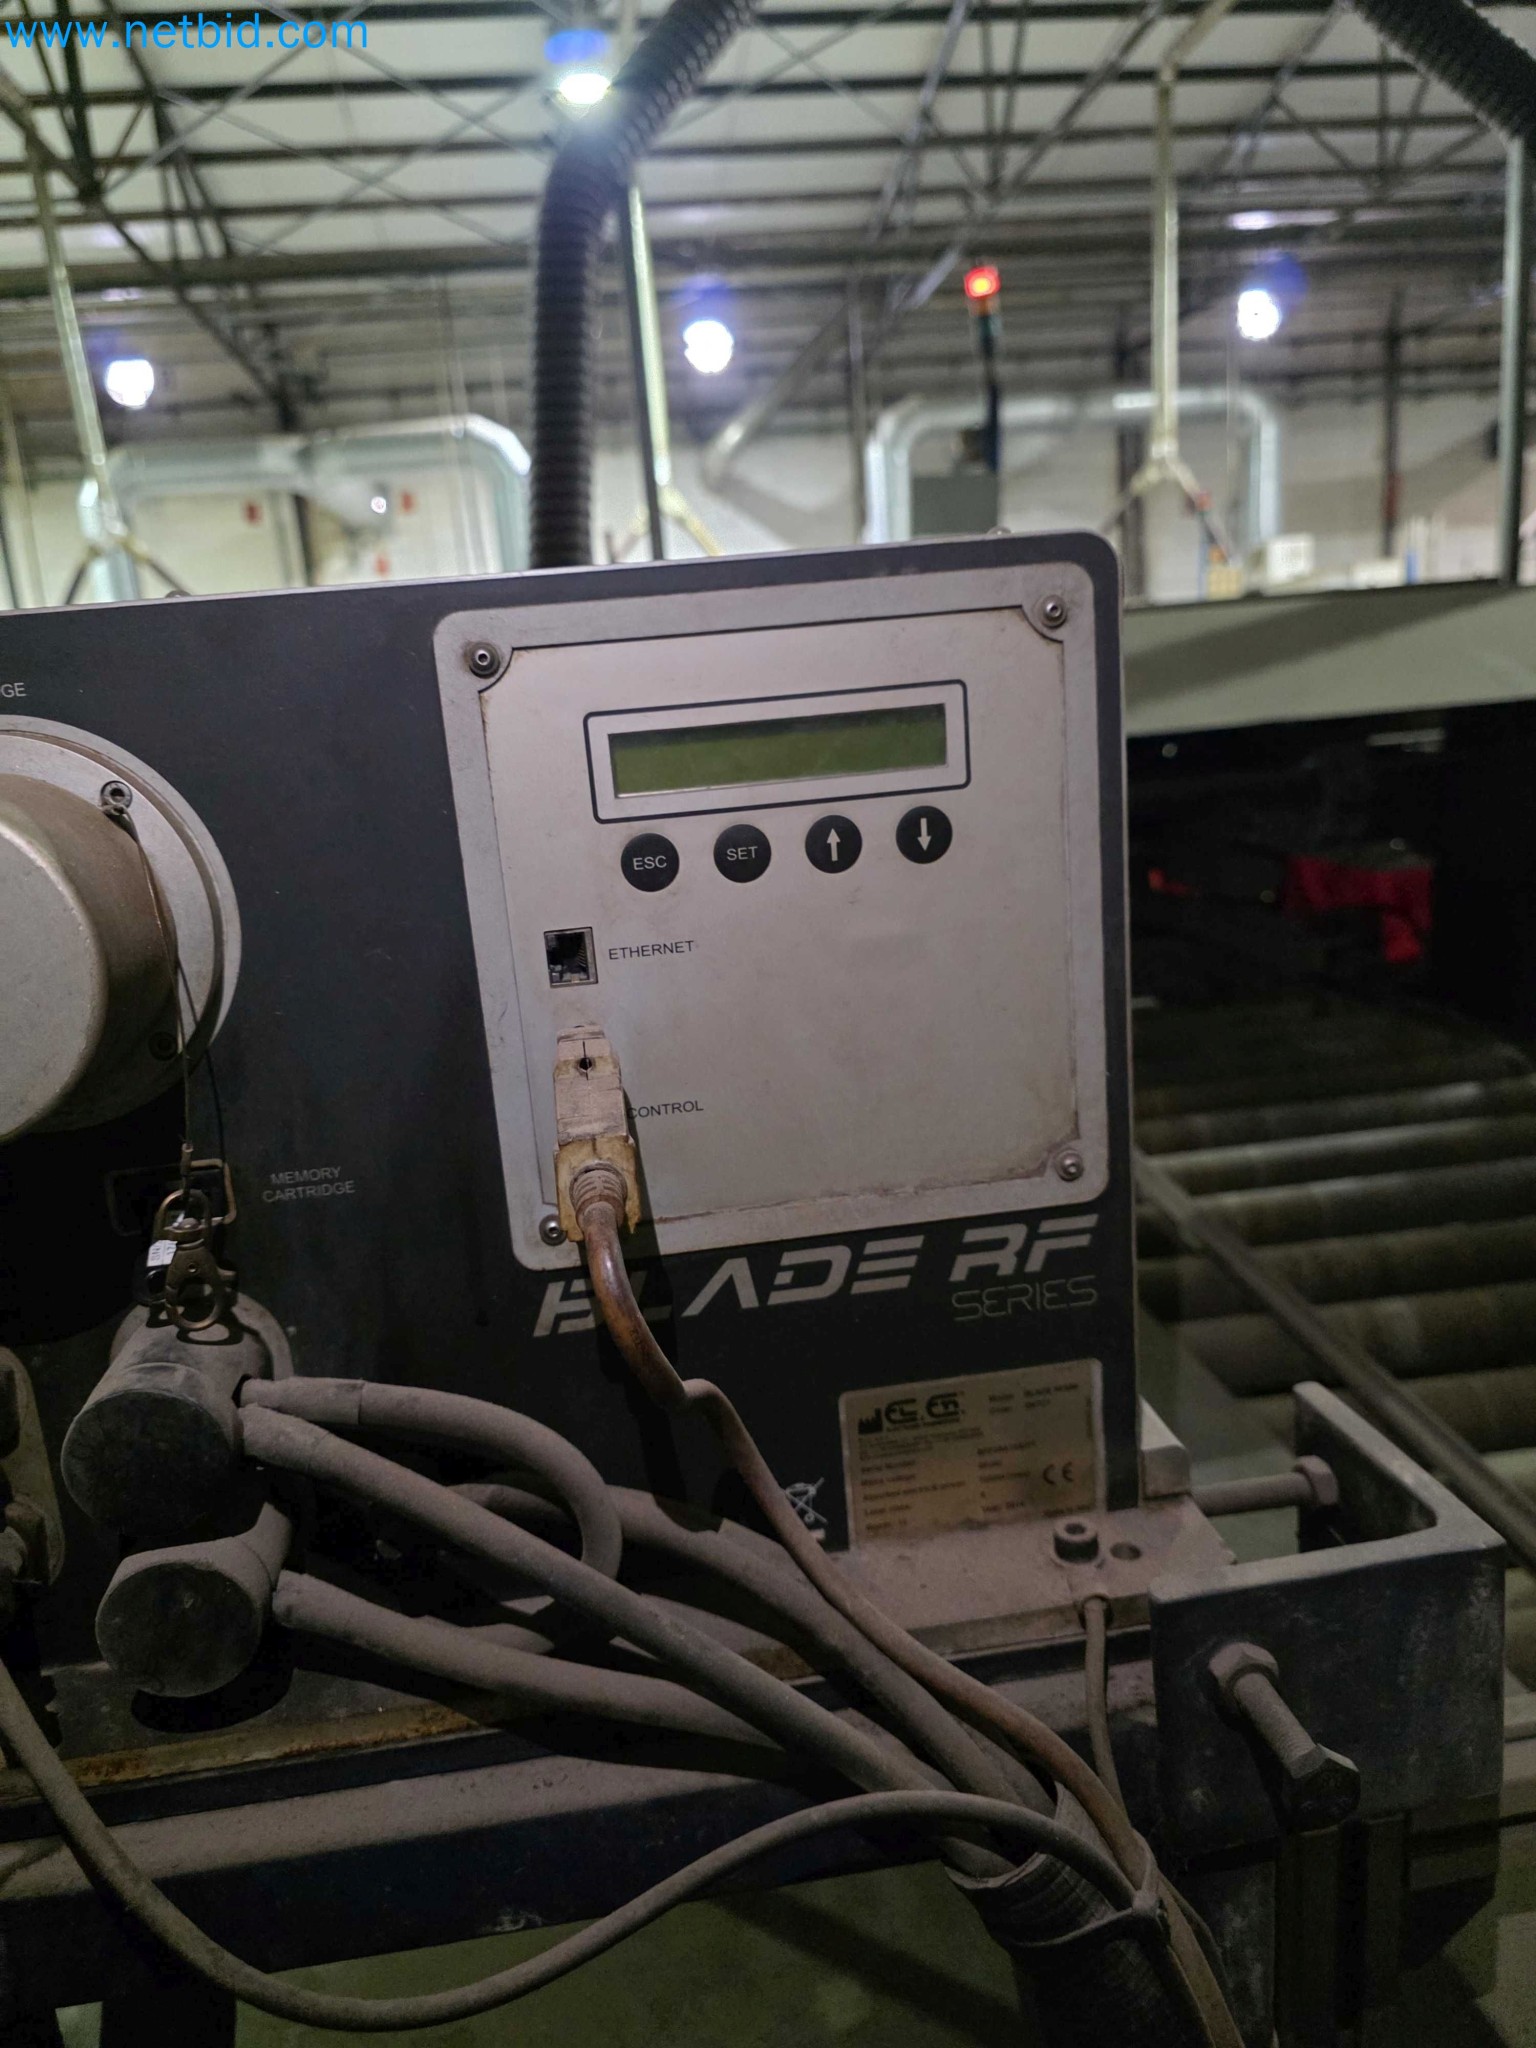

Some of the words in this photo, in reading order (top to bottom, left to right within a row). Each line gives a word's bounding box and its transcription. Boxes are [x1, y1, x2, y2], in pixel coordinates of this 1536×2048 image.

[632, 855, 668, 871] ESC
[726, 846, 759, 861] SET
[608, 940, 695, 960] ETHERNET
[269, 1166, 342, 1185] MEMORY
[262, 1180, 356, 1203] CARTRIDGE
[949, 1213, 1099, 1284] RF
[951, 1276, 1099, 1322] SERIES
